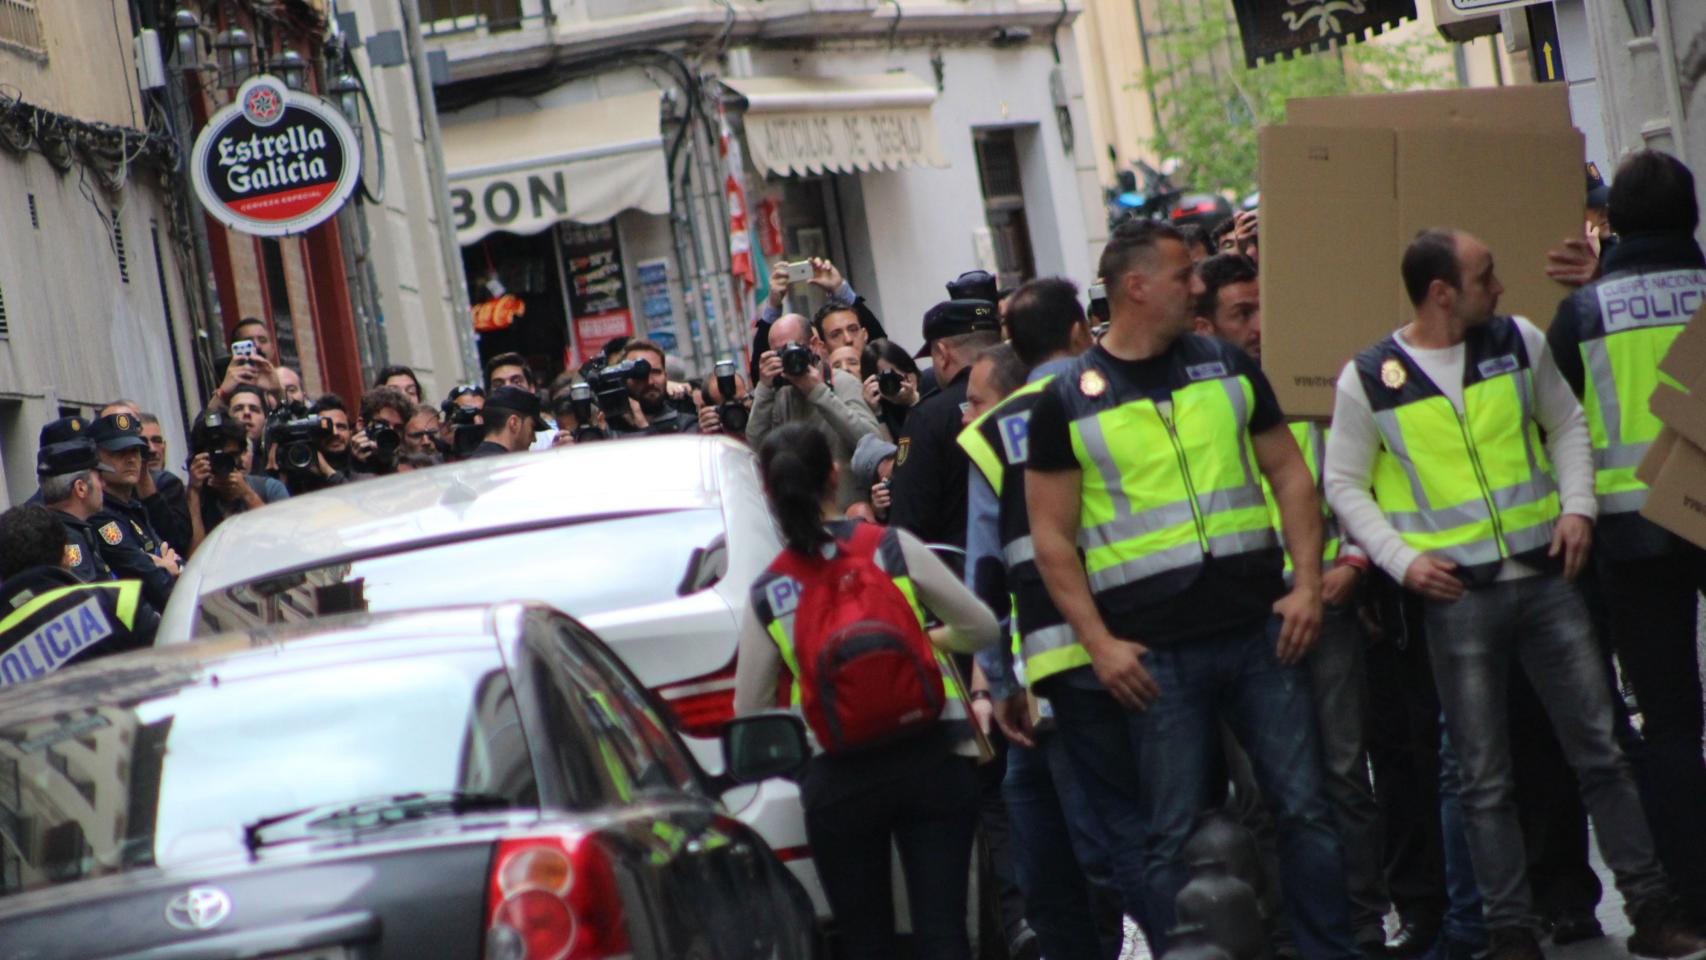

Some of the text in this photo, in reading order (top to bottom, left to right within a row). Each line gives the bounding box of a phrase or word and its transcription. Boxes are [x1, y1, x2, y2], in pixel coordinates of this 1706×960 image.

[217, 124, 327, 166] Estrella
[226, 153, 328, 193] Galicia
[0, 605, 105, 686] OLICIA
